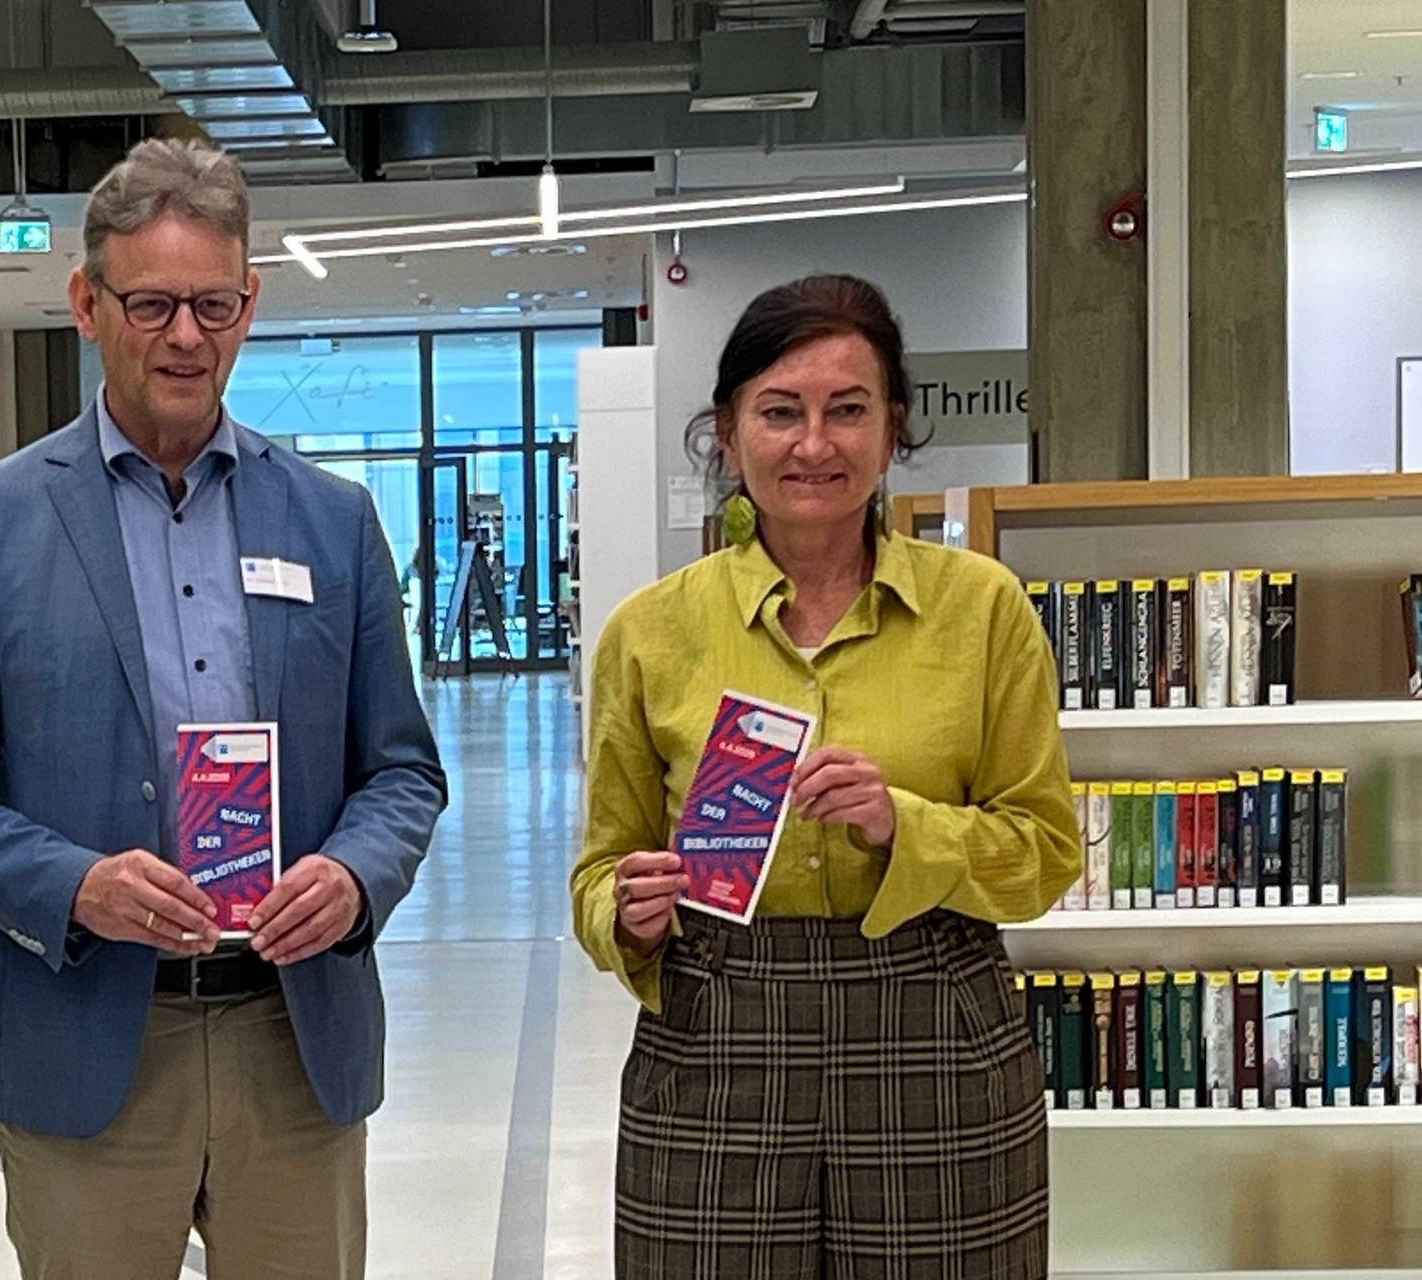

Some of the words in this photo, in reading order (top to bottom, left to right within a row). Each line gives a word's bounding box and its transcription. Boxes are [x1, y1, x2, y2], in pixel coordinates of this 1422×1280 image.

[915, 379, 1028, 416] Thrille
[732, 783, 772, 812] NACHT
[219, 808, 261, 826] NACHT
[701, 803, 726, 820] DER
[197, 835, 222, 849] DER
[682, 836, 769, 850] BIBLIOTHEKEN
[190, 848, 272, 886] BIBLIOTHEKEN
